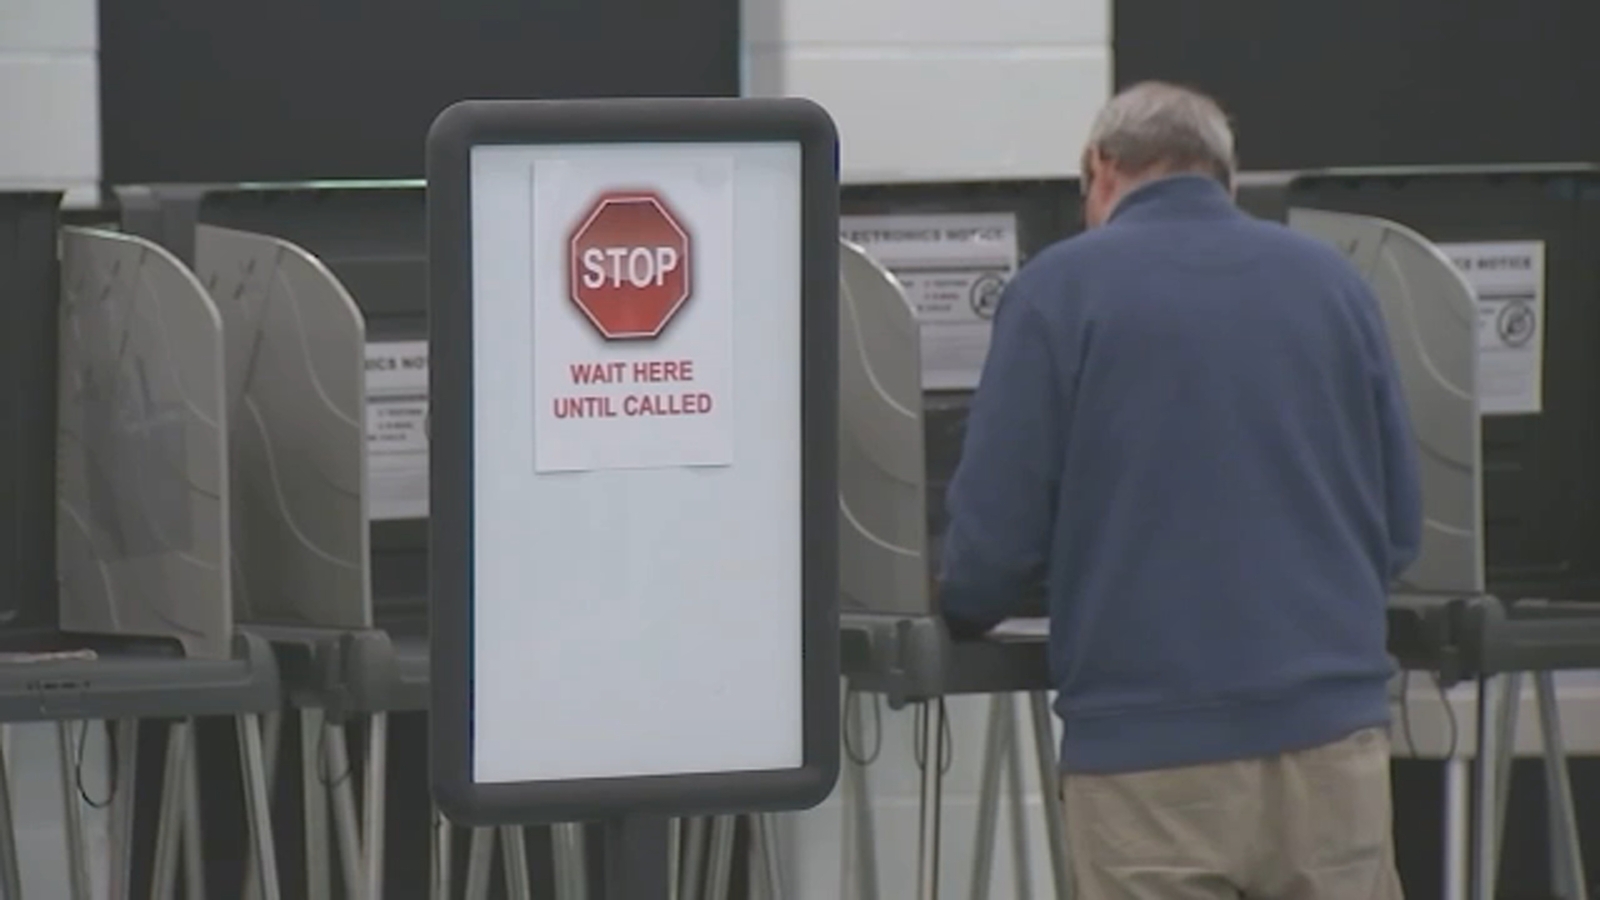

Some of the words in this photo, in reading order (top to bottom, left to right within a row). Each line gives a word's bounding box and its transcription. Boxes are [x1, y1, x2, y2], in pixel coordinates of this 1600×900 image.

[583, 247, 677, 288] STOP
[570, 363, 627, 384] WAIT
[633, 361, 693, 382] HERE
[553, 397, 617, 418] UNTIL
[624, 393, 712, 416] CALLED
